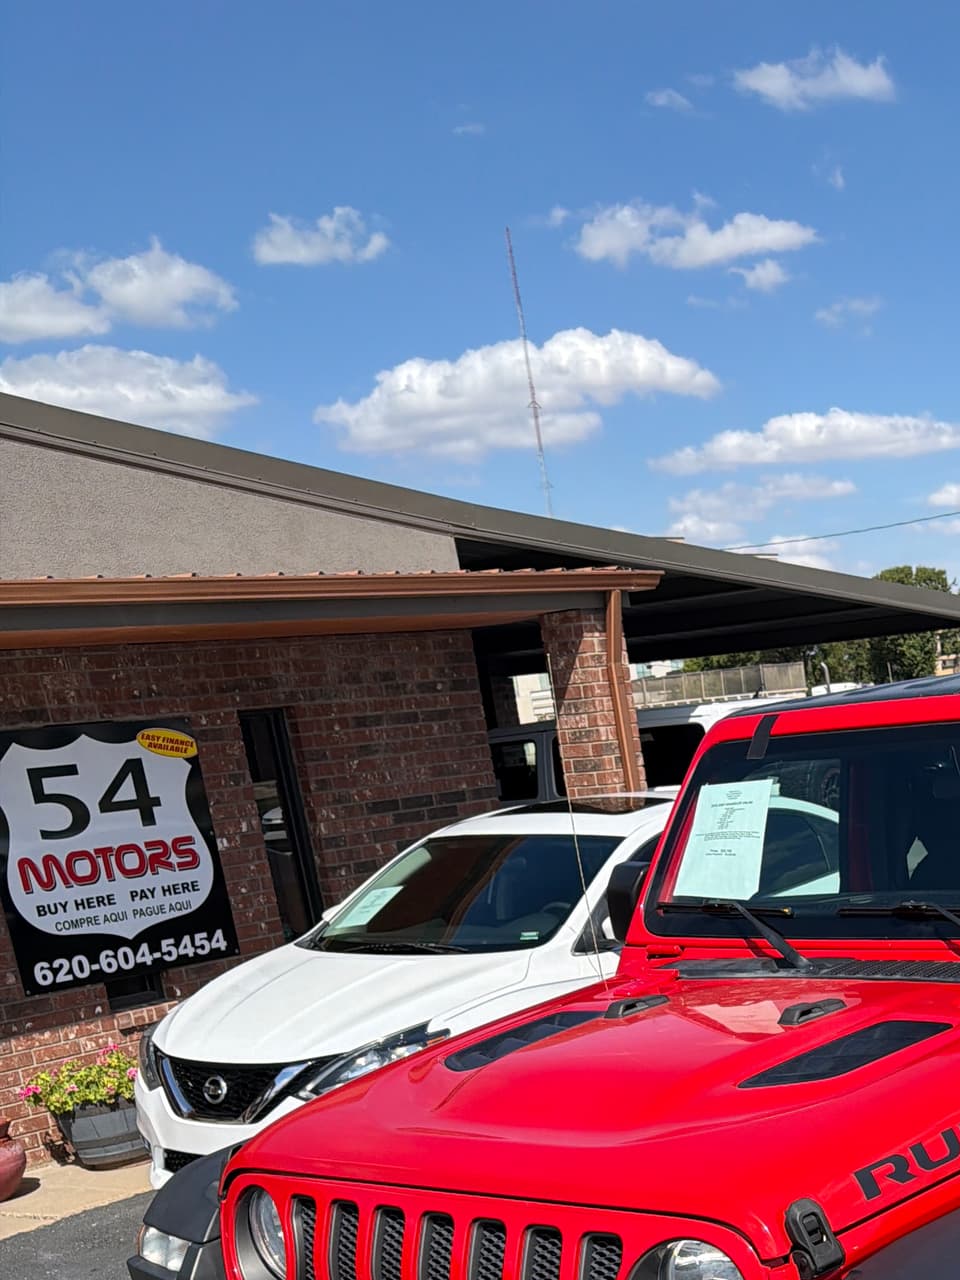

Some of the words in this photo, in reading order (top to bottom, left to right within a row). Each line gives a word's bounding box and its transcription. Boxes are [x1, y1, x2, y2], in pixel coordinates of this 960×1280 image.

[141, 733, 161, 742] EASY
[147, 742, 188, 754] AVAILABLE
[26, 757, 162, 840] 54
[17, 835, 200, 895] MOTORS
[36, 901, 69, 918] BUY
[75, 893, 117, 912] HERE
[129, 887, 157, 902] PAY
[161, 880, 201, 897] HERE
[55, 915, 101, 932] COMPRE
[103, 911, 128, 925] AQUI
[132, 903, 167, 920] PAGUE
[168, 899, 192, 913] AQUI
[33, 928, 227, 986] 620-604-5454
